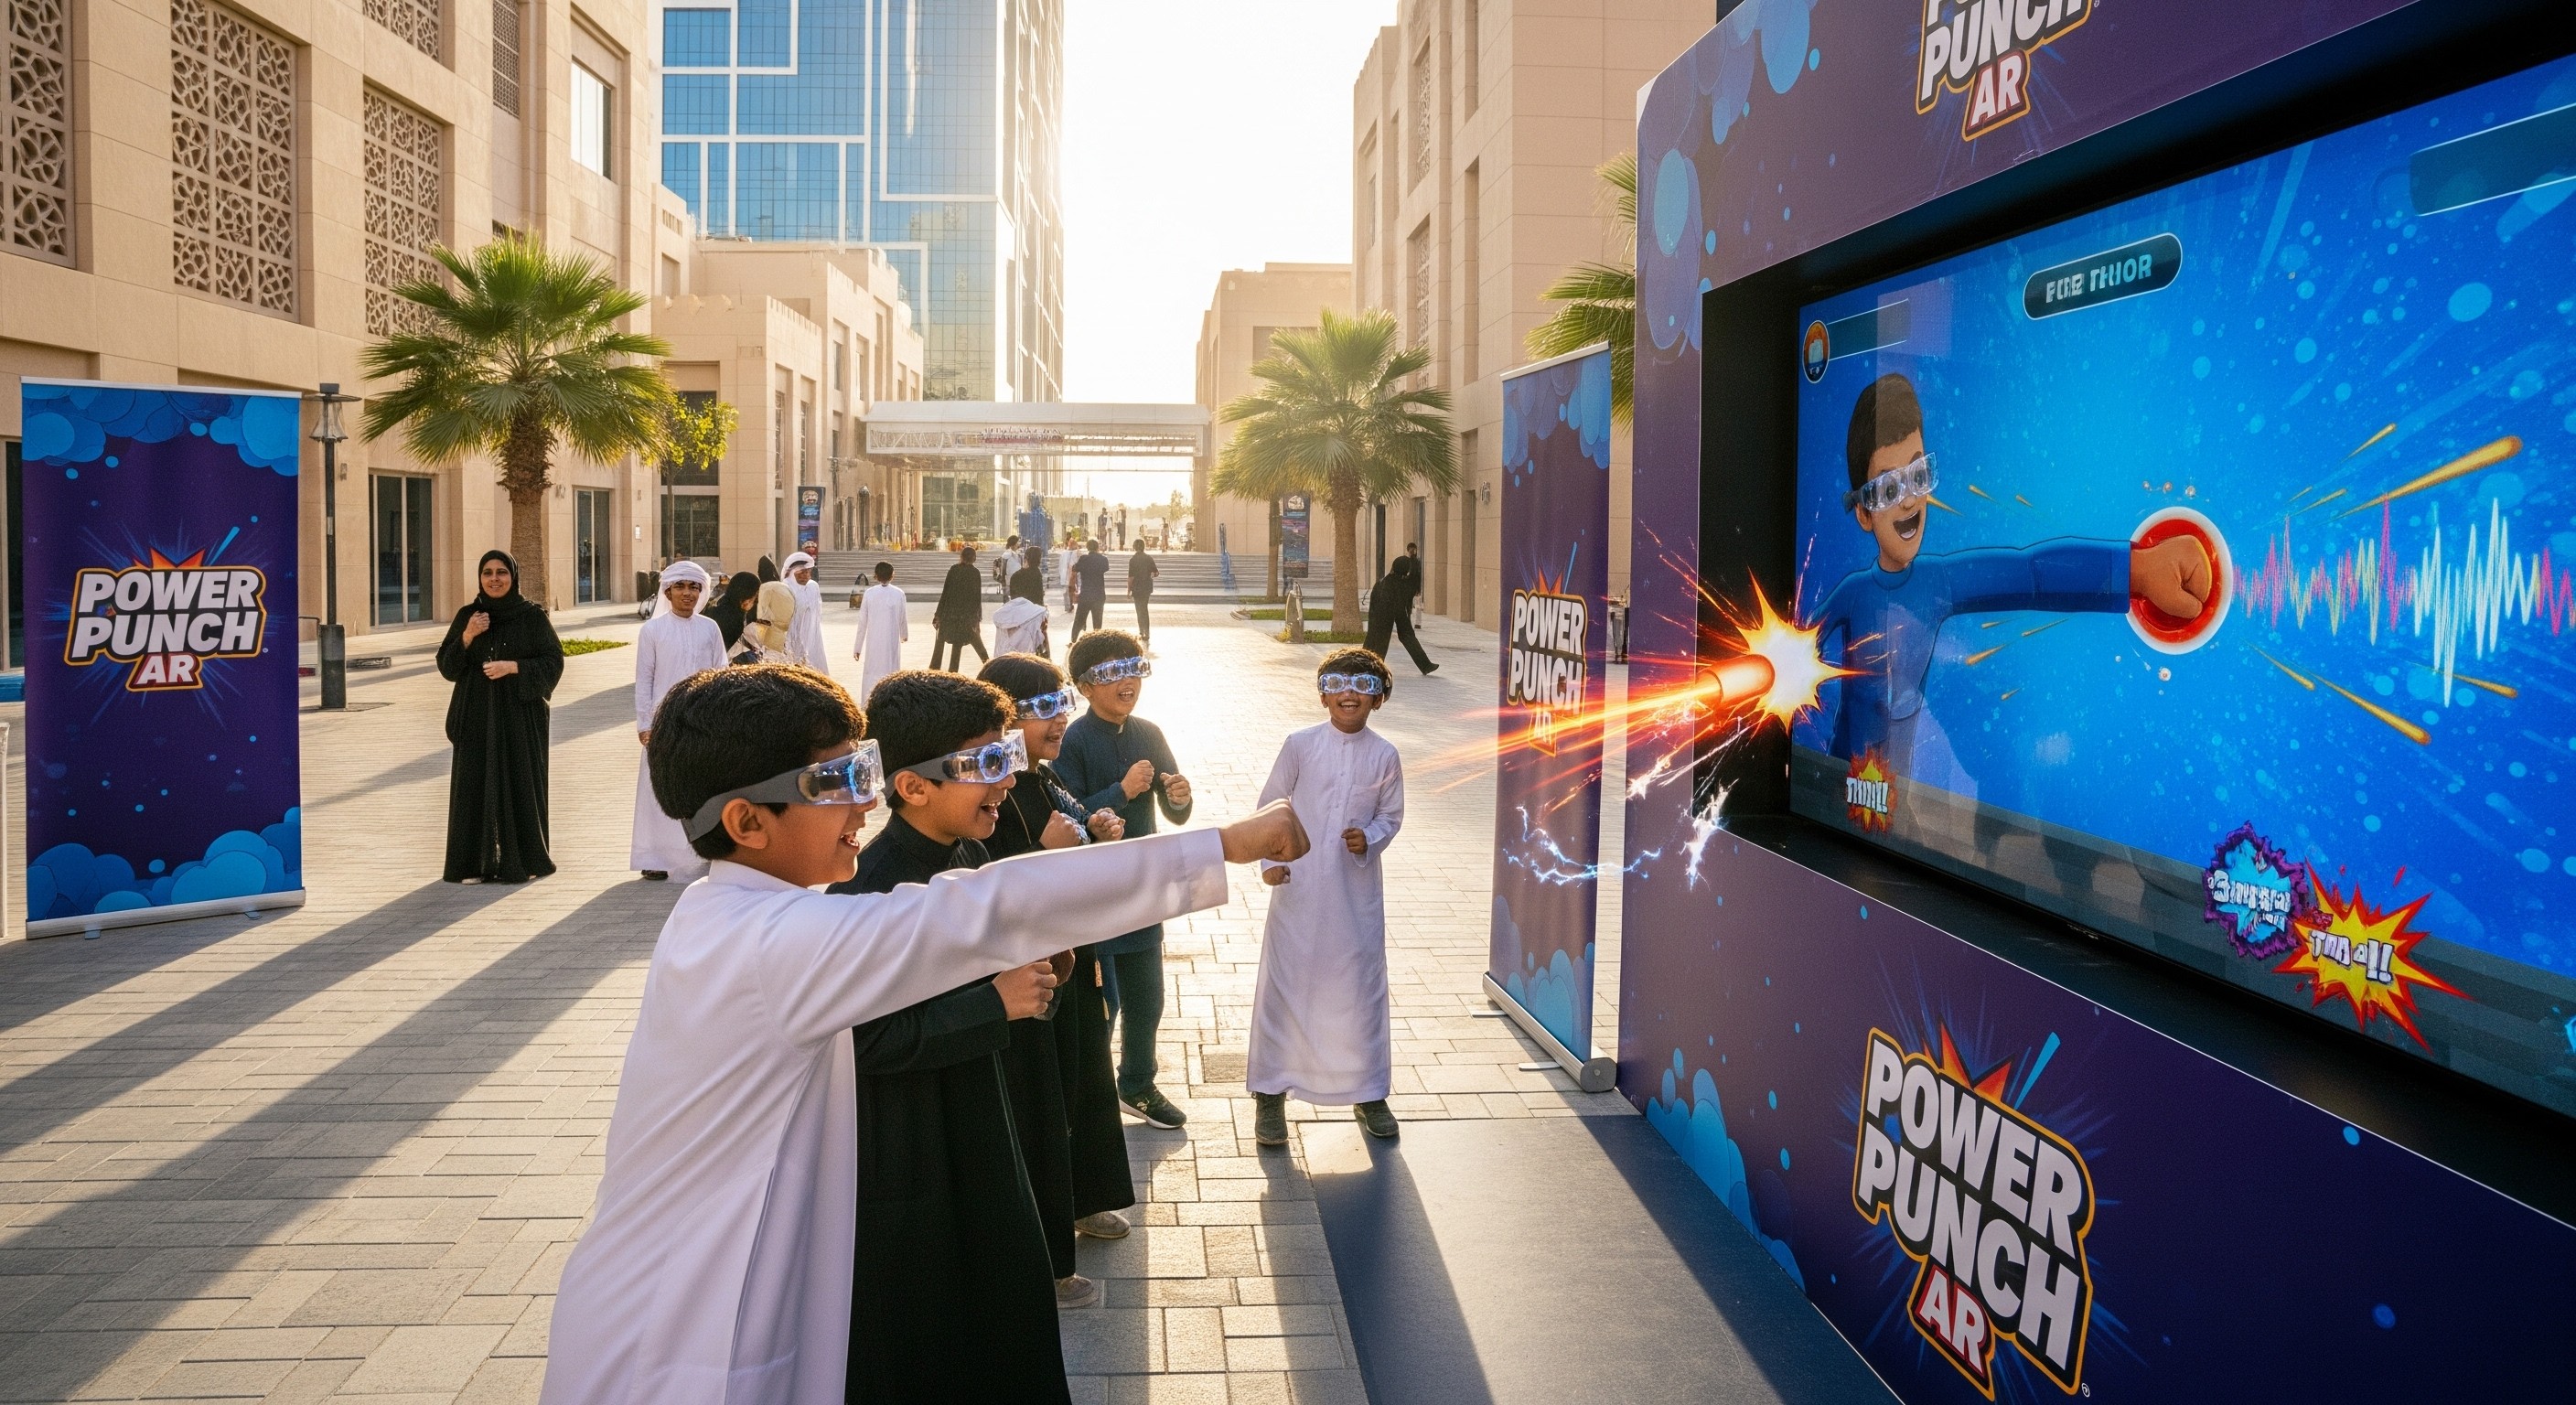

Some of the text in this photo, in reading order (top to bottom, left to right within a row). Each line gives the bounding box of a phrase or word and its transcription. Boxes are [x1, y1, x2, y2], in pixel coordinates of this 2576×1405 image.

[1970, 53, 2023, 128] AR
[78, 571, 260, 613] POWER
[1512, 595, 1584, 656] POWER
[71, 612, 259, 658] PUNCH
[136, 653, 195, 685] AR
[1508, 648, 1583, 715] PUNCH
[1866, 1038, 2082, 1260] POWER
[1858, 1121, 2080, 1371] PUNCH
[1919, 1269, 1985, 1375] AR
